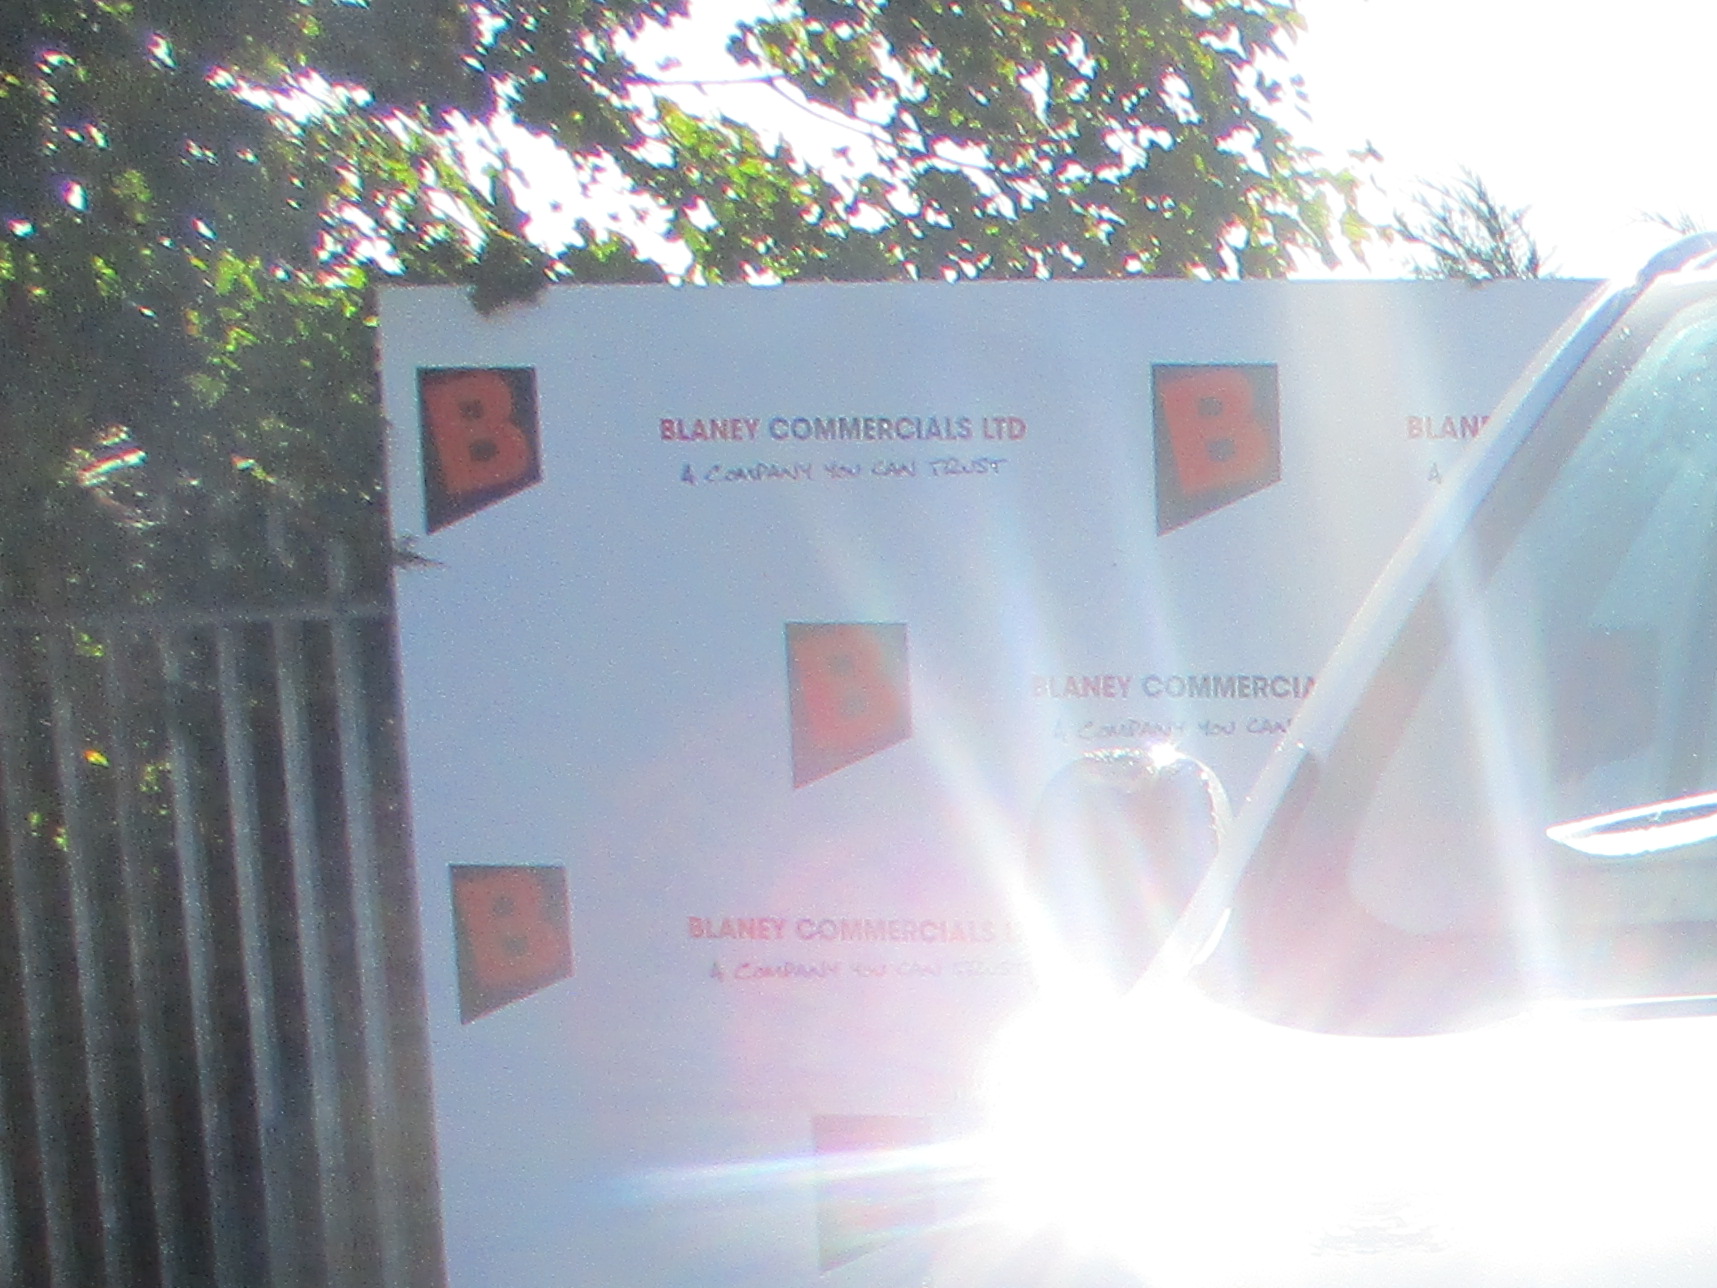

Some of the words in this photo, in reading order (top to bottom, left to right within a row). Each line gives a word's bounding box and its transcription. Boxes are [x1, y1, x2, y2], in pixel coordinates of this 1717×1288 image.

[424, 371, 526, 494] B
[659, 418, 760, 441] BLANEY
[769, 417, 973, 441] COMMERCIALS
[983, 418, 1028, 440] LTD
[1163, 370, 1271, 493] B
[1406, 415, 1491, 439] BLAN
[681, 464, 697, 485] A
[704, 461, 814, 482] COMPANY
[824, 459, 861, 480] YOU
[872, 459, 917, 478] CAN
[929, 456, 1007, 477] TRUST
[793, 625, 904, 751] B
[1031, 675, 1133, 698] BLANEY
[459, 869, 560, 987] B
[687, 916, 788, 940] BLANEY
[795, 917, 995, 943] COMMERCIALS
